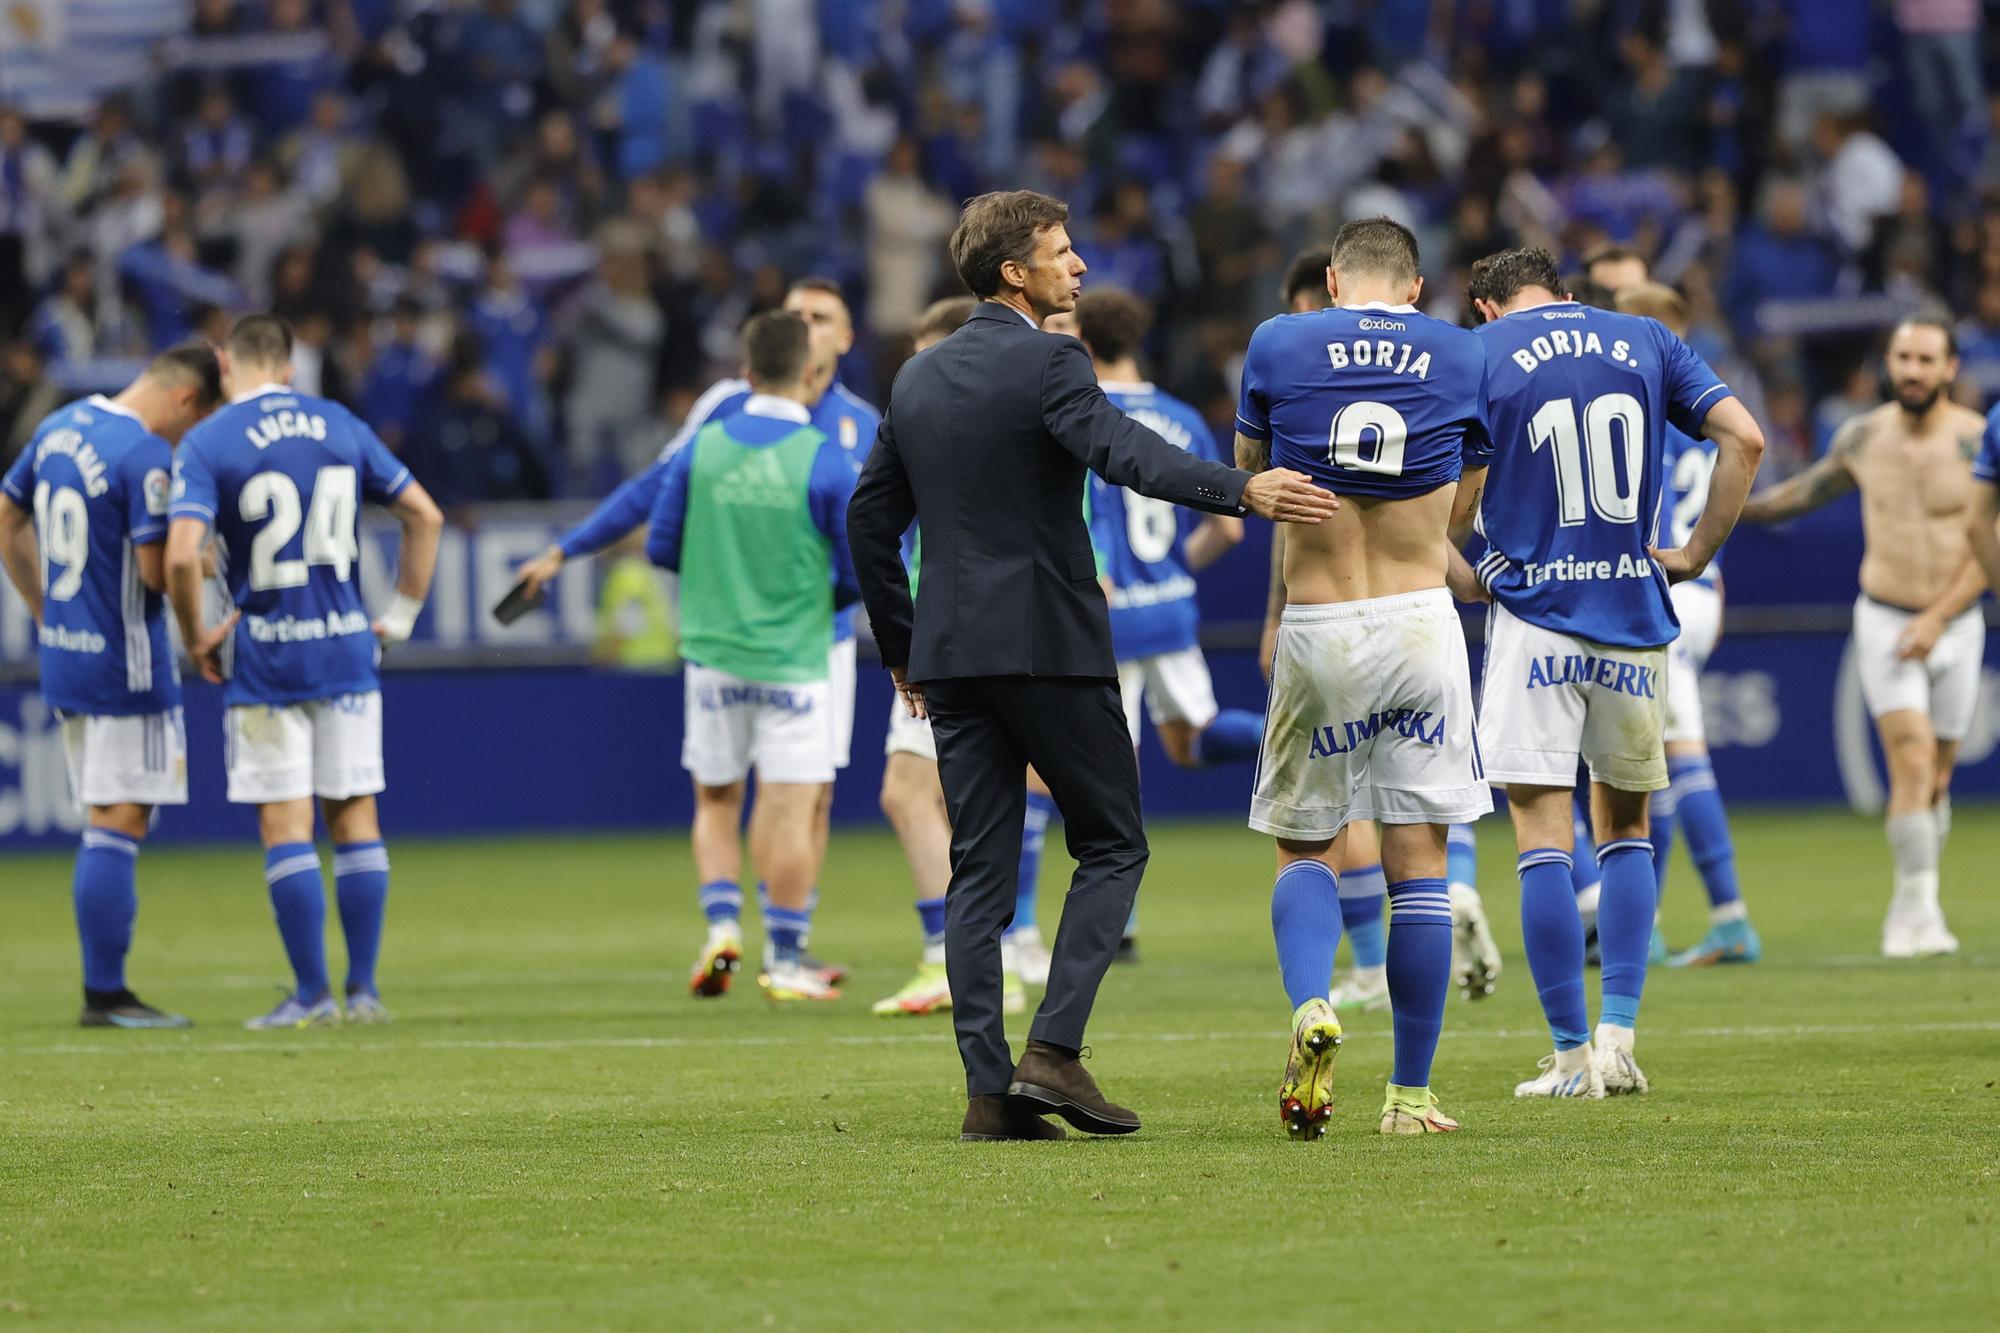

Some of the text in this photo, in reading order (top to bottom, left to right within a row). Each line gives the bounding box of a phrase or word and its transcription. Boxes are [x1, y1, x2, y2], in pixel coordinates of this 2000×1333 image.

[1358, 318, 1406, 331] exiom
[1327, 339, 1432, 380] BORJA
[1511, 329, 1638, 374] BORJA S.
[245, 410, 327, 450] LUCAS
[1527, 392, 1645, 528] 10
[1670, 447, 1720, 549] 2
[33, 479, 89, 602] 19
[238, 464, 360, 593] 24
[1615, 553, 1652, 579] Au
